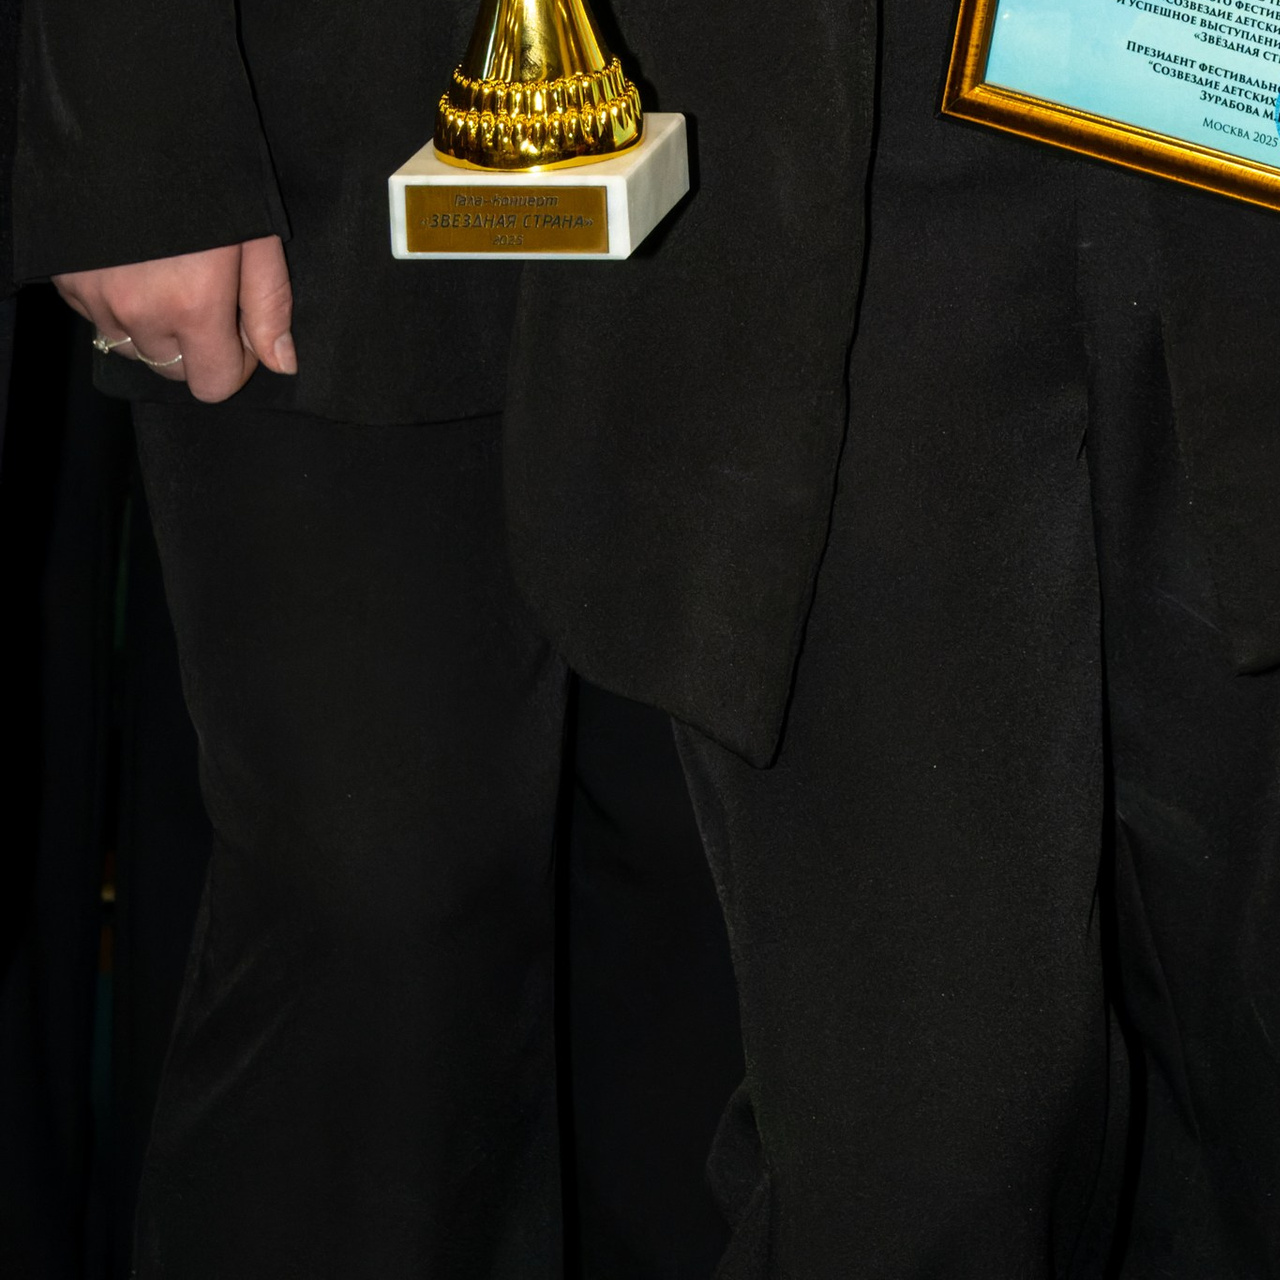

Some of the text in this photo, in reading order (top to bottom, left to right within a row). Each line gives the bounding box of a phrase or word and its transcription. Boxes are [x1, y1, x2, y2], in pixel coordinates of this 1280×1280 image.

[1129, 0, 1197, 26] УСПЕШНОЕ
[1126, 40, 1197, 69] ПРЕЗИДЕНТ
[1194, 32, 1260, 58] «ЗВЁЗДНАЯ
[1199, 89, 1260, 117] ЗУРАБОВА
[1222, 84, 1278, 108] ДЕТСКИХ
[1202, 117, 1279, 148] МОСКВА 2025
[523, 213, 594, 229] СТРАНА»
[492, 234, 524, 246] 2025
